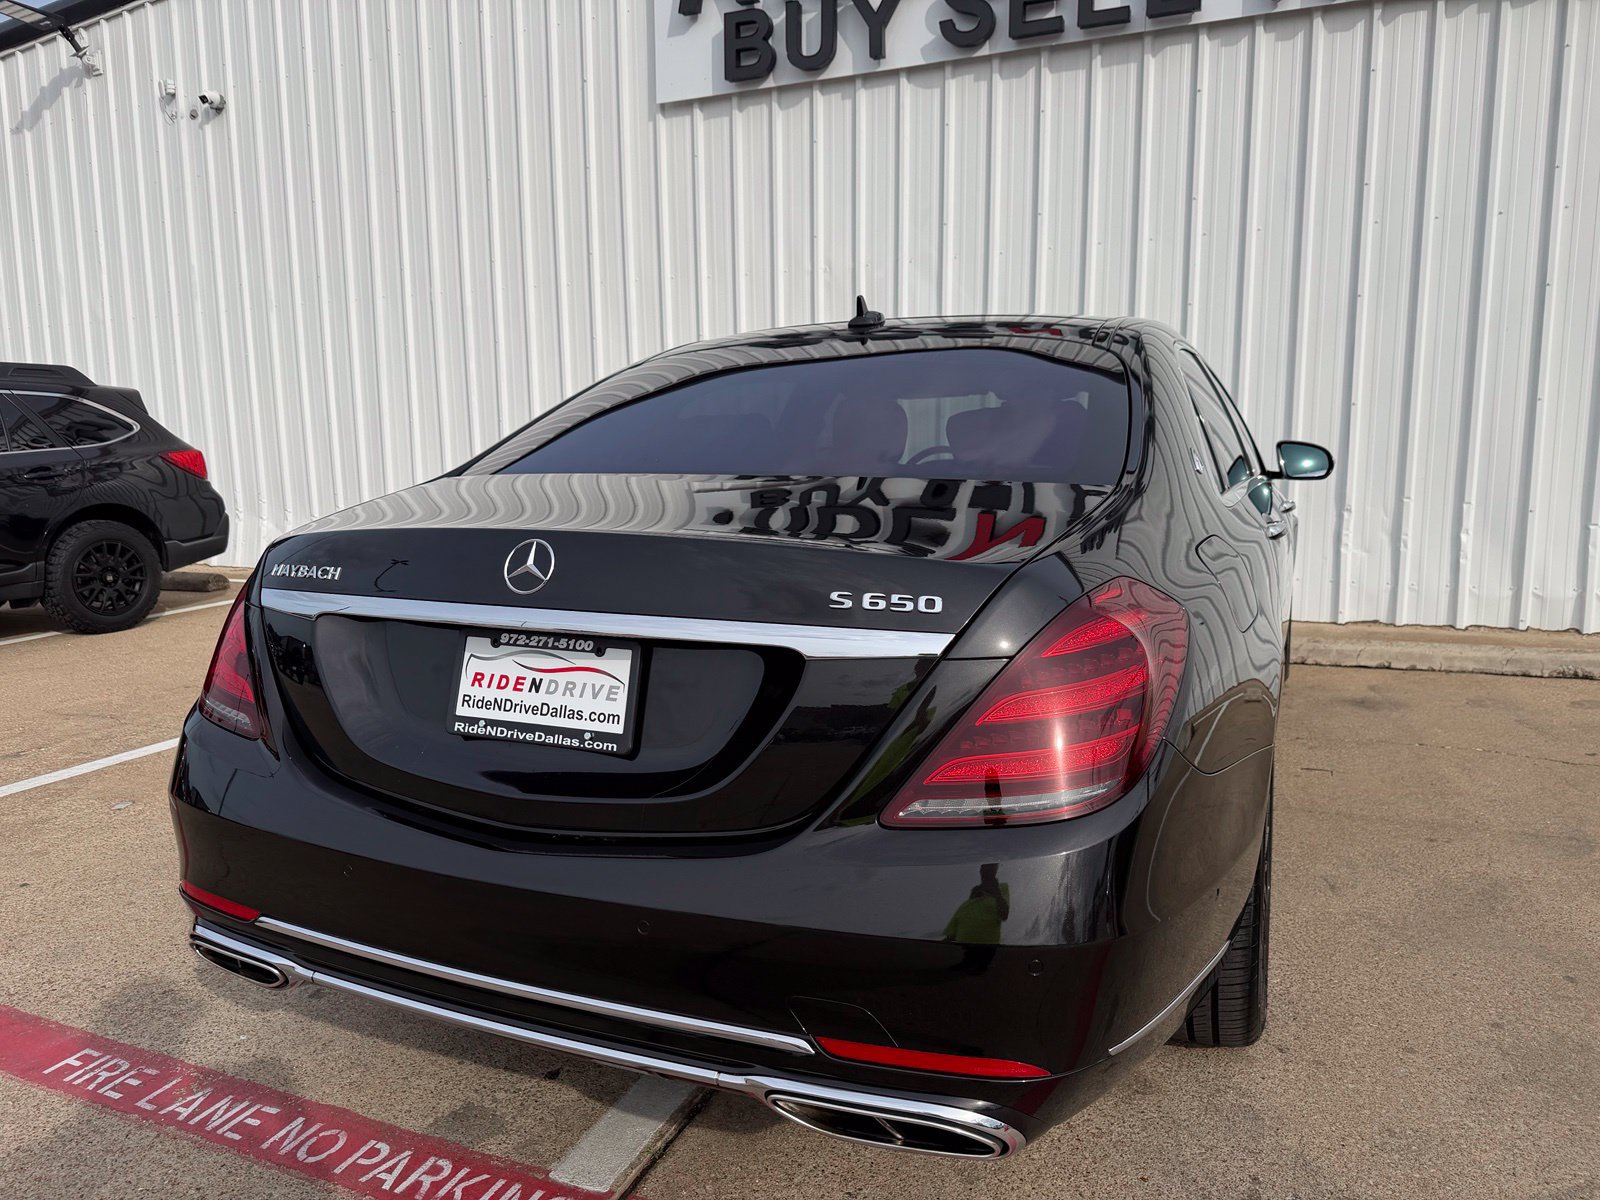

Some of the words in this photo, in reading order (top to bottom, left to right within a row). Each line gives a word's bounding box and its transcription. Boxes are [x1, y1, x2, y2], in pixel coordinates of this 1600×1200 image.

[724, 0, 900, 82] BUY
[271, 563, 342, 580] MAYBACH
[828, 591, 853, 609] S
[862, 592, 943, 613] 650
[500, 633, 594, 651] 972-271-5100
[470, 671, 621, 702] RIDENDRIVE
[461, 694, 620, 725] RideNDriveDallas.com
[454, 721, 618, 752] RideNDriveDallas.com
[42, 1048, 160, 1100] FIRE
[135, 1076, 281, 1141] LANE
[259, 1116, 348, 1164] NO
